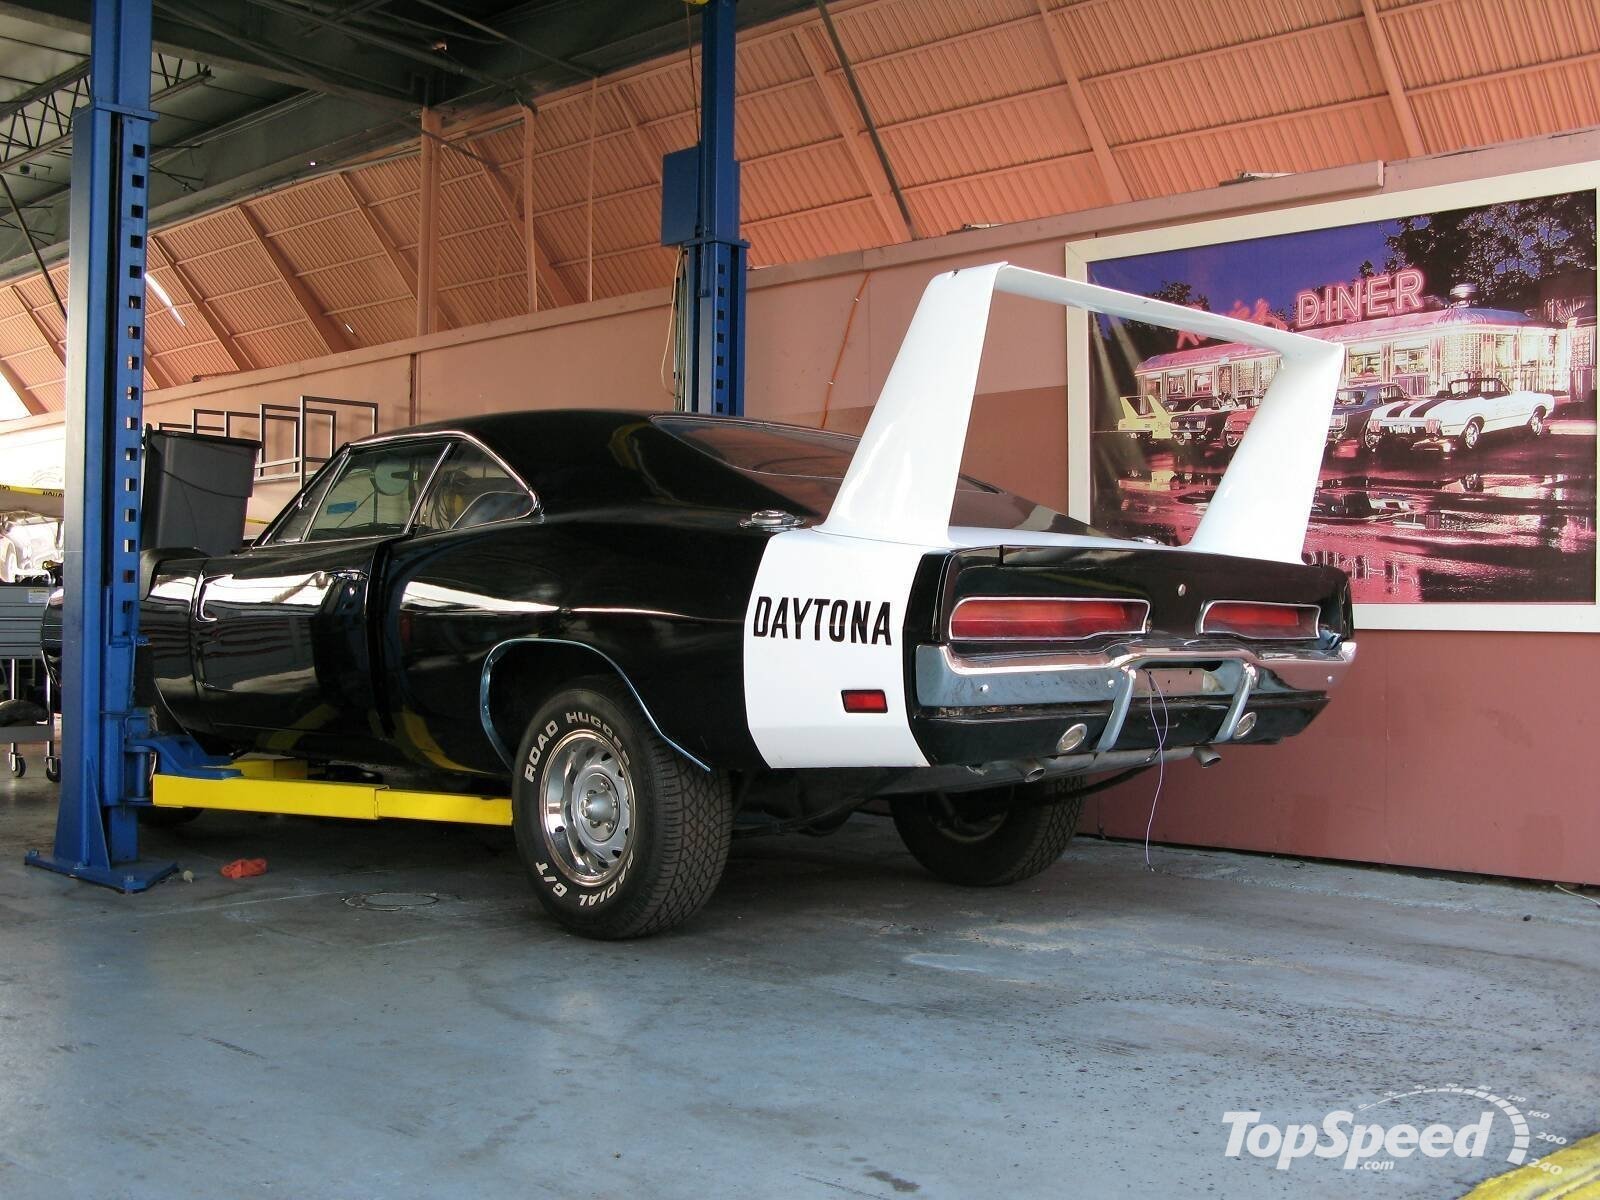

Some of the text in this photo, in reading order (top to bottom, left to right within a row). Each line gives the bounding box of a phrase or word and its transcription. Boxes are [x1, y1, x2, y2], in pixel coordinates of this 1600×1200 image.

[1298, 269, 1424, 328] DINER
[753, 596, 892, 646] DAYTONA
[524, 720, 559, 783] ROAD
[535, 862, 568, 898] G/T
